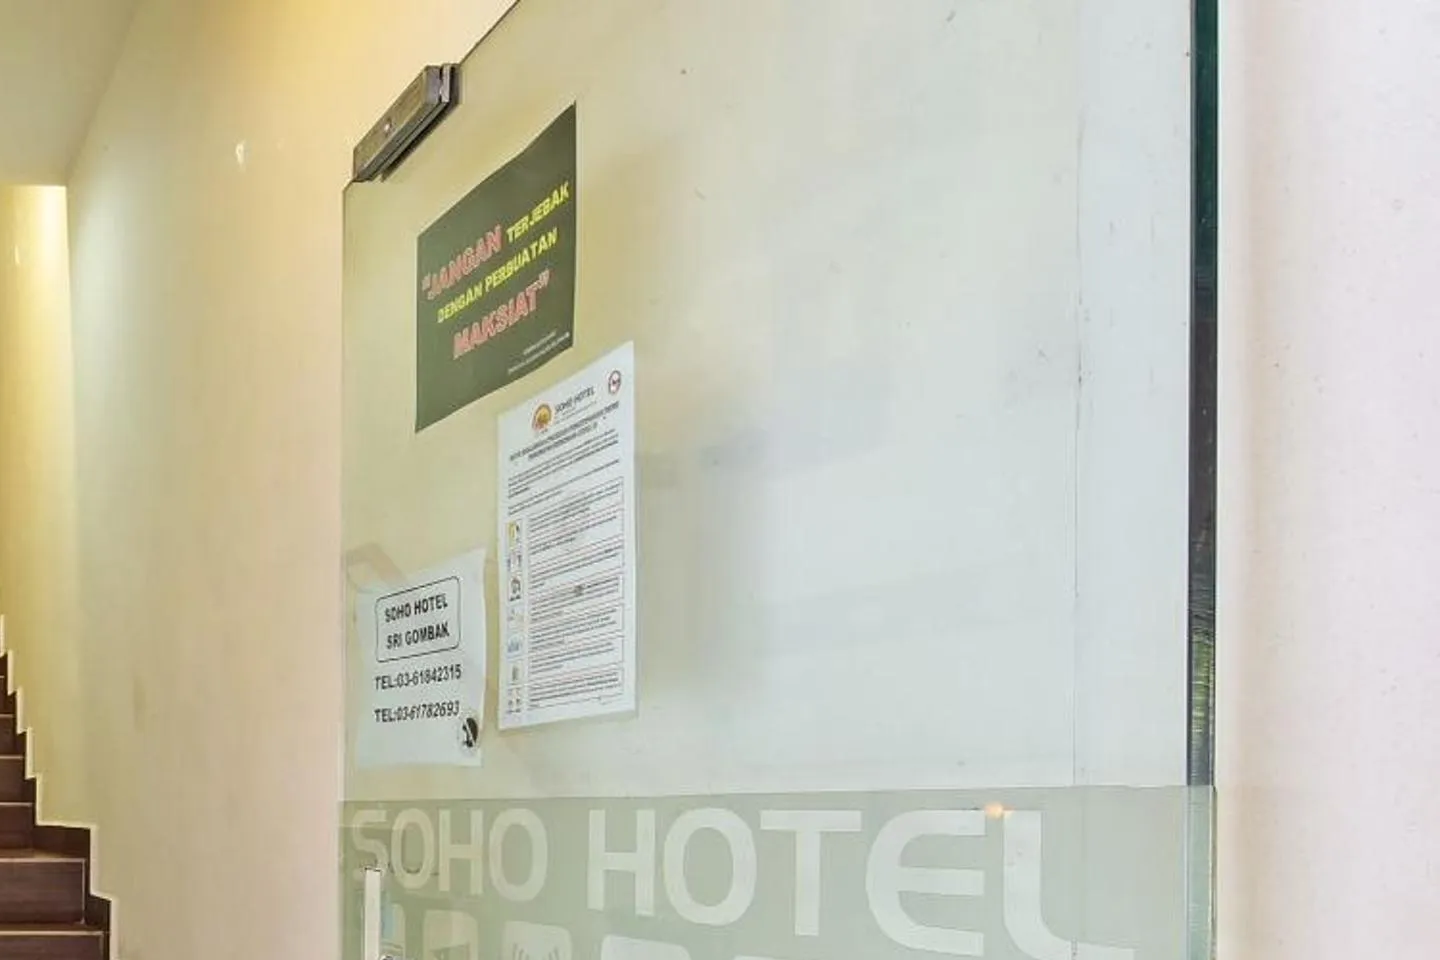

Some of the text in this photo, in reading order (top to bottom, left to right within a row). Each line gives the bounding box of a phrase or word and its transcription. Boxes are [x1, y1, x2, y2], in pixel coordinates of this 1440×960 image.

[506, 180, 570, 243] TERJEBAK
[437, 226, 558, 324] DENGAN PERBUATAN
[573, 386, 595, 406] HOTEL
[385, 593, 449, 623] SOHO HOTEL
[386, 621, 450, 650] SRI GOMBAK
[352, 808, 548, 901] SOHO
